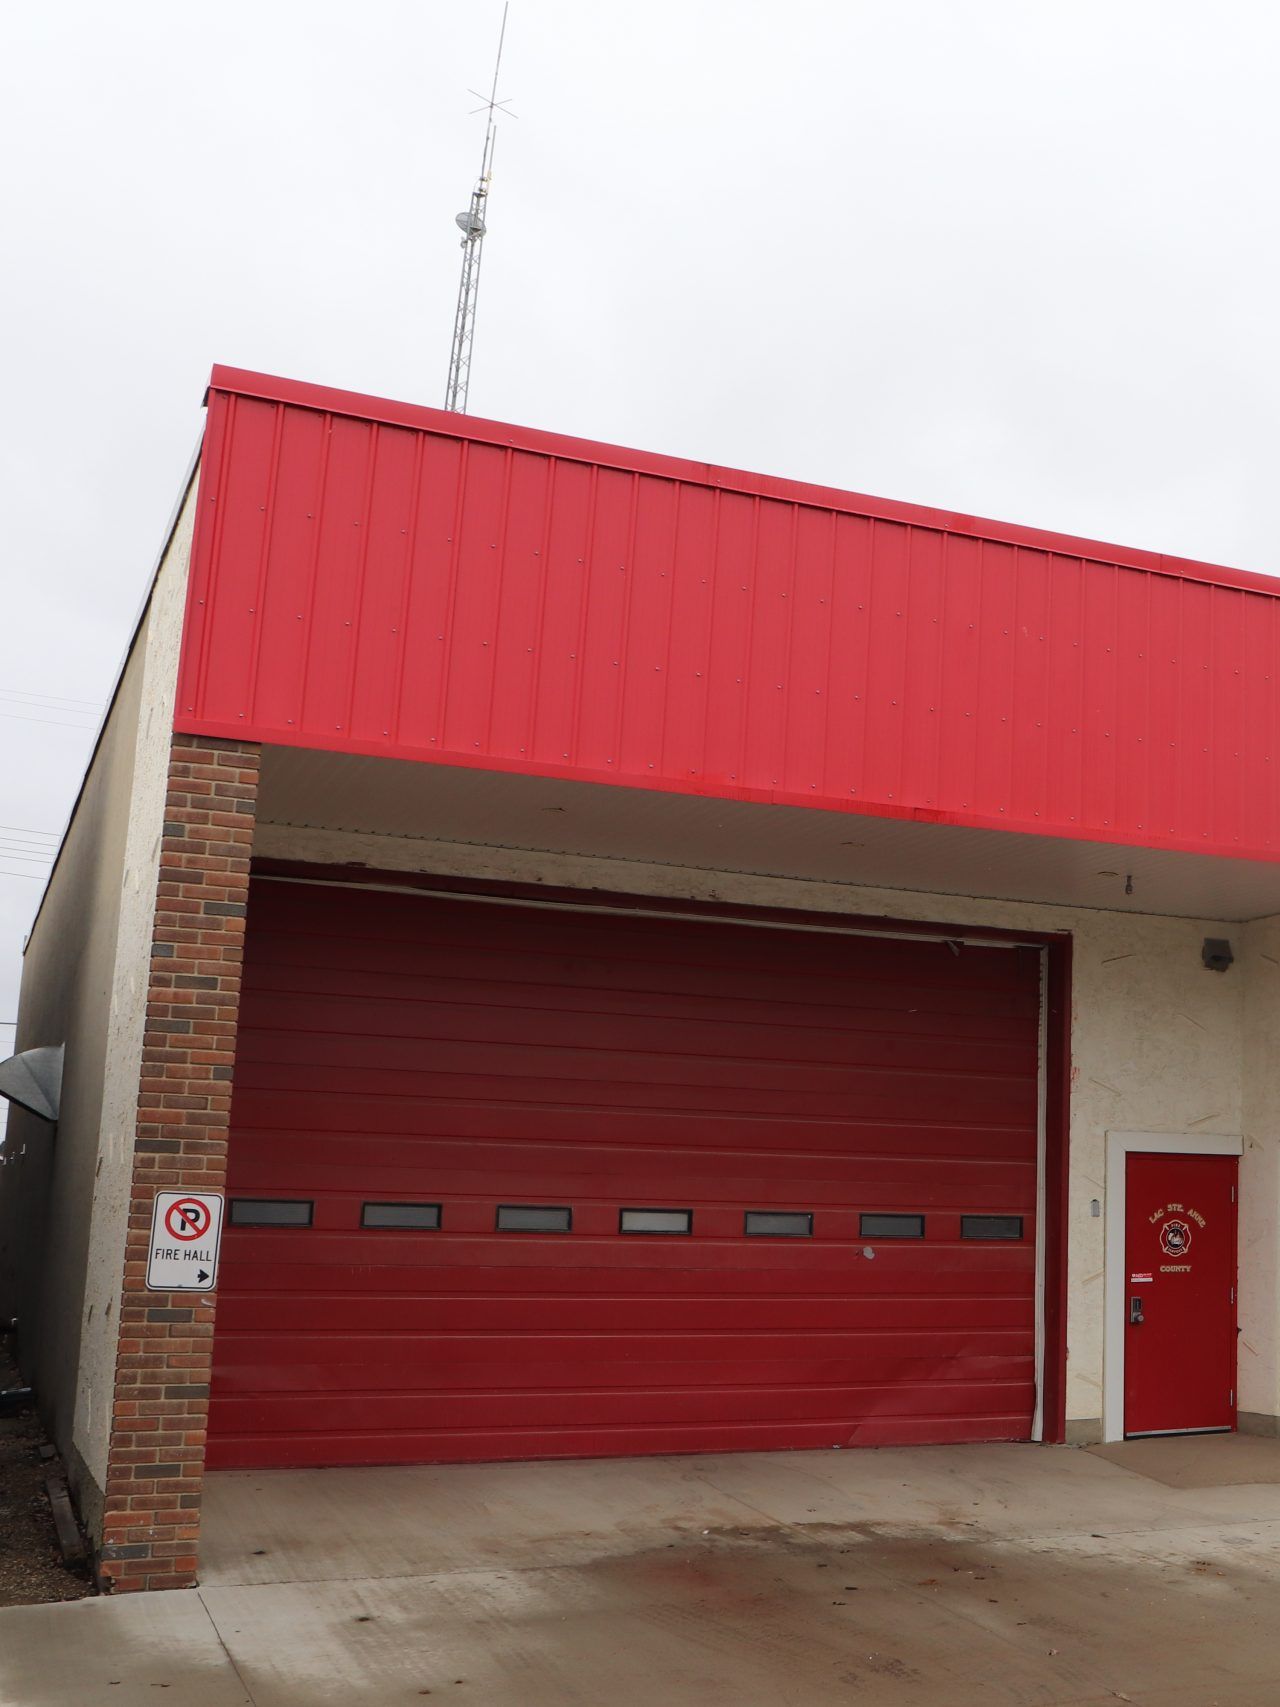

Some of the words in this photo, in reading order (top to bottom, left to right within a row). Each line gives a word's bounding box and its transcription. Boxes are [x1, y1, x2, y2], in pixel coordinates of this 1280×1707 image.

[1149, 1209, 1164, 1224] LAC
[1187, 1209, 1206, 1228] ANNE
[155, 1248, 180, 1260] FIRE
[184, 1250, 212, 1261] HALL
